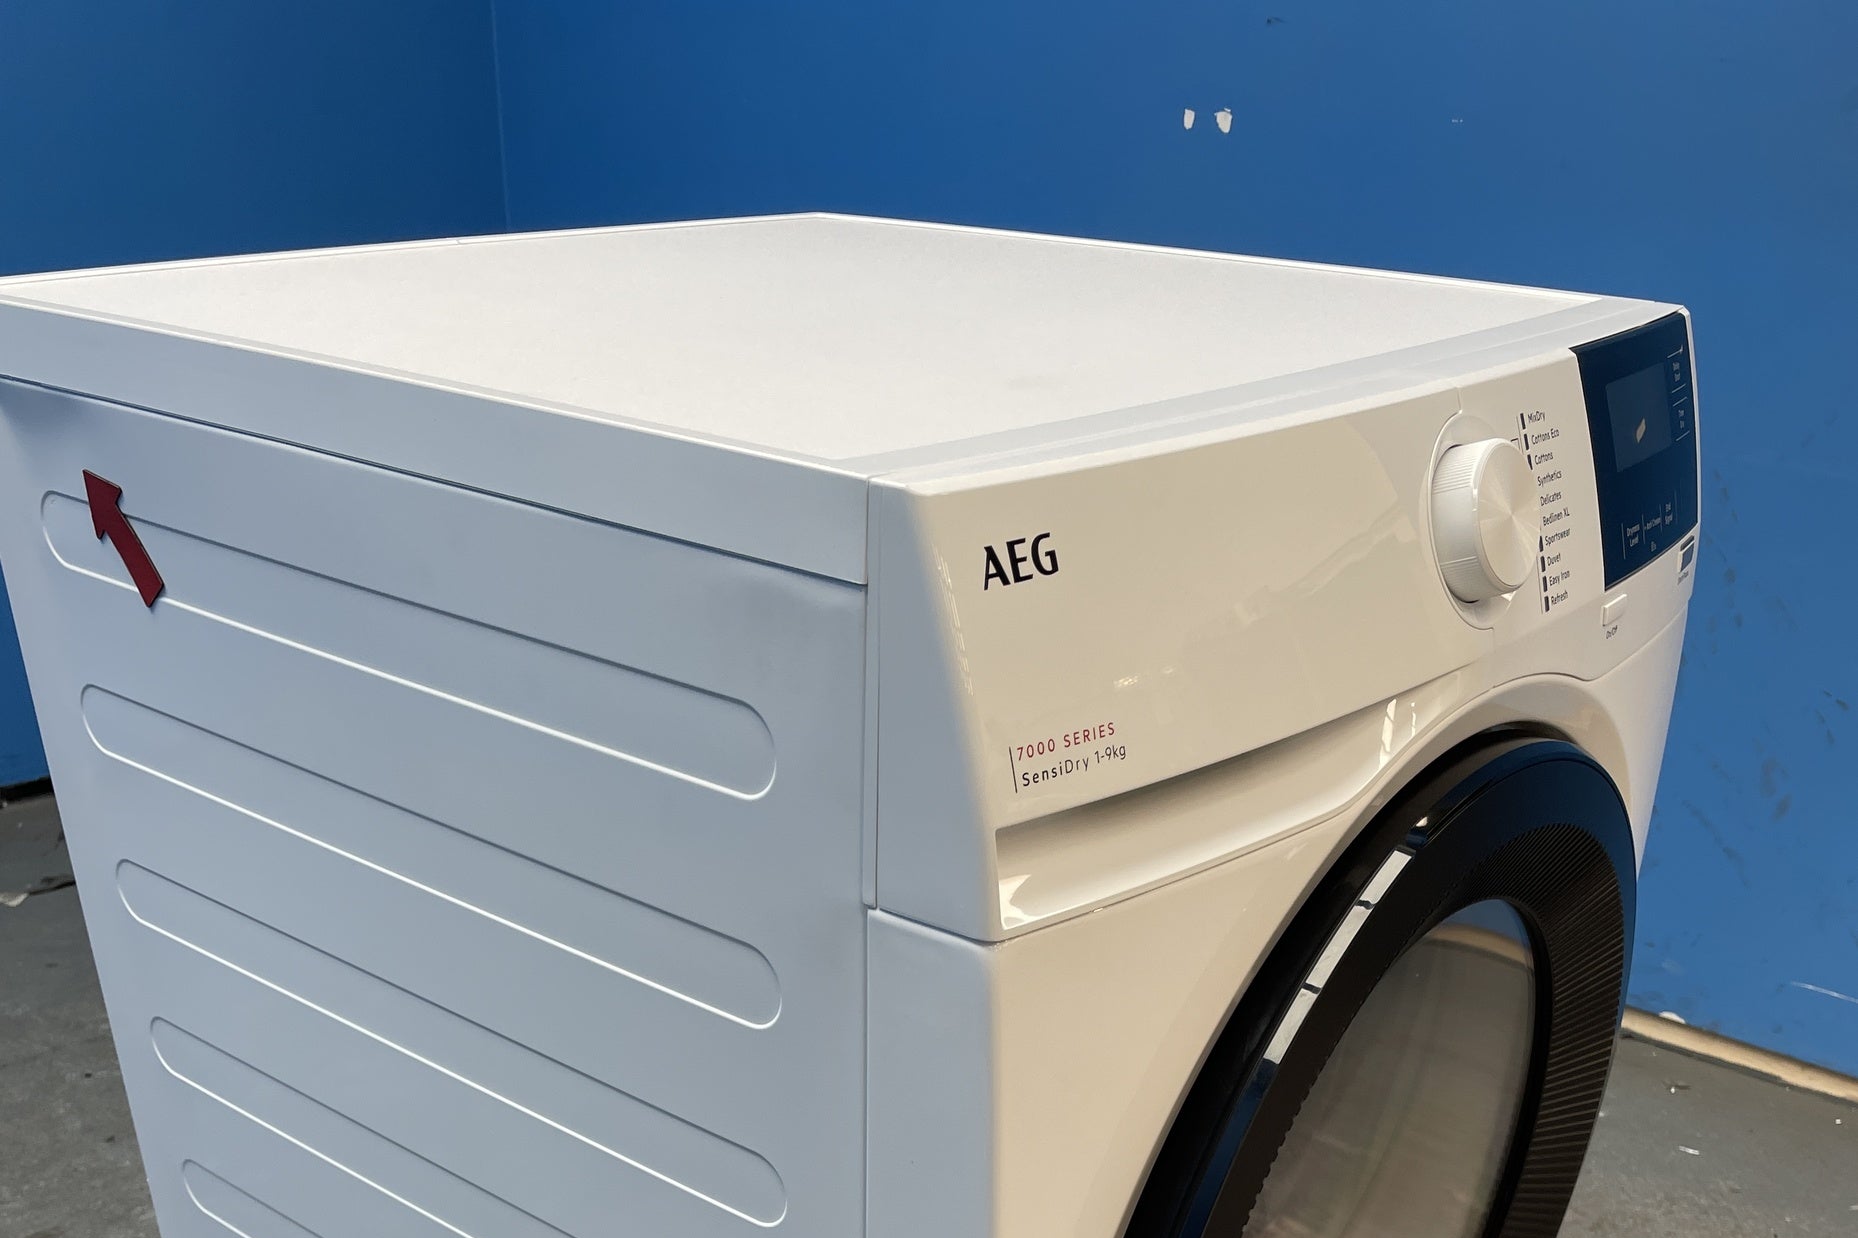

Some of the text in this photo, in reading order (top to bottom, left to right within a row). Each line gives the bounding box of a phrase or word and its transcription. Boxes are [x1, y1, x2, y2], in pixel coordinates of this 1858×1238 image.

[1531, 428, 1560, 445] Cottons Eco
[1535, 452, 1554, 465] Cottons
[1537, 471, 1562, 487] Synthetics
[1540, 492, 1561, 506] Delicates
[1544, 528, 1571, 546] Sportswear
[983, 532, 1059, 591] AEG
[1549, 576, 1560, 586] Easy
[1551, 590, 1569, 605] Refresh
[1017, 722, 1116, 761] 7000 SERIES
[1022, 744, 1127, 787] SensiDry 1-9kg
